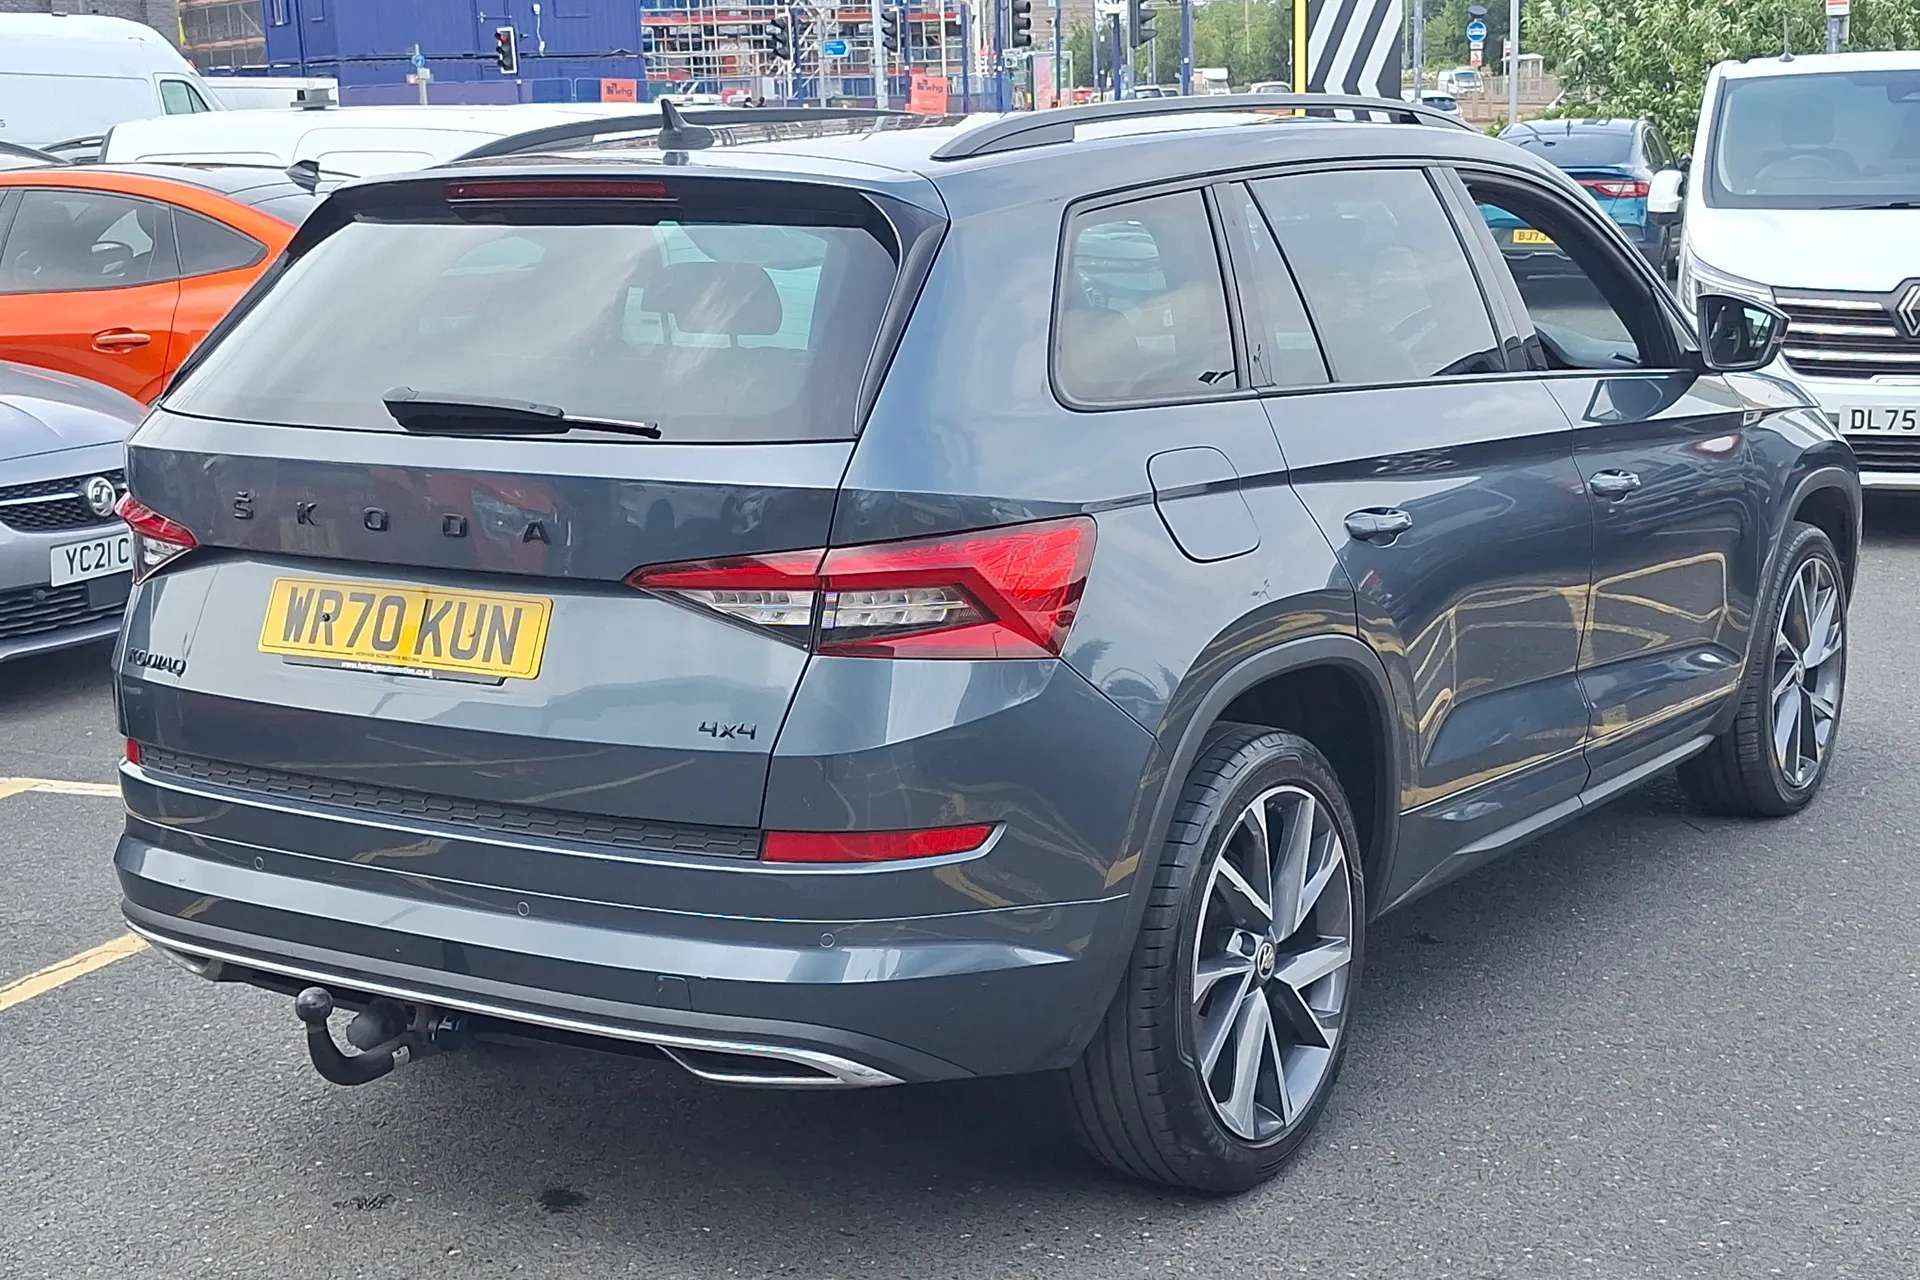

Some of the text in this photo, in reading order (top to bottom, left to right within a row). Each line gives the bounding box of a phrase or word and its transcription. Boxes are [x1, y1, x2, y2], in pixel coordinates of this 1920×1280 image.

[1850, 409, 1916, 430] DL75
[233, 491, 549, 545] ŠKODA
[66, 538, 129, 575] YC21 C
[283, 587, 522, 665] WR70 KUN
[129, 648, 186, 678] KODIAQ
